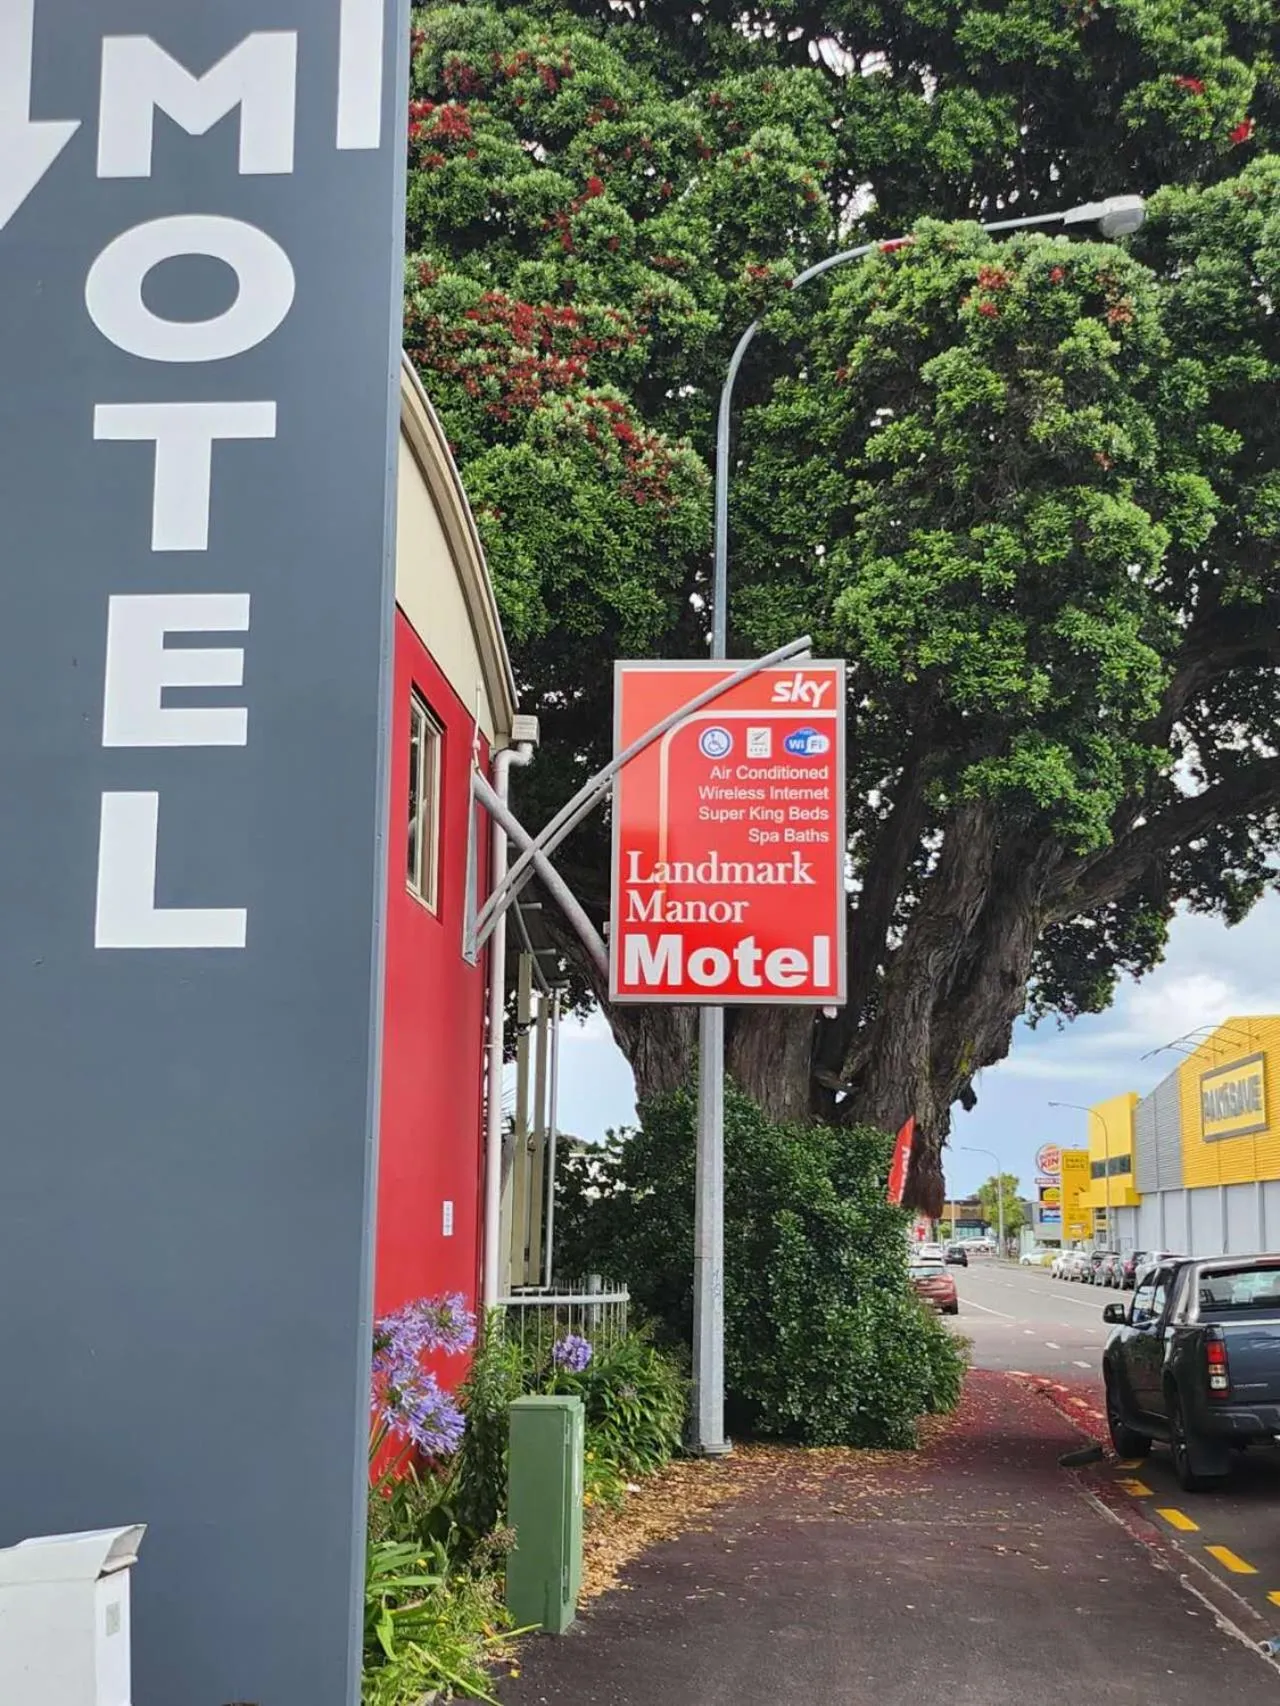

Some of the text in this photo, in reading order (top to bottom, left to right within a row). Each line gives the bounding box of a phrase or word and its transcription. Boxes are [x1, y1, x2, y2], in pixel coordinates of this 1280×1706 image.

[85, 31, 297, 949] MOTEL
[771, 672, 832, 709] sky
[710, 765, 829, 780] Air Conditioned
[698, 786, 830, 801] Wireless Internet
[698, 806, 830, 825] Super King Beds
[748, 828, 830, 846] Spa Baths
[626, 850, 816, 885] Landmark
[625, 889, 749, 924] Manor
[624, 933, 831, 988] Motel
